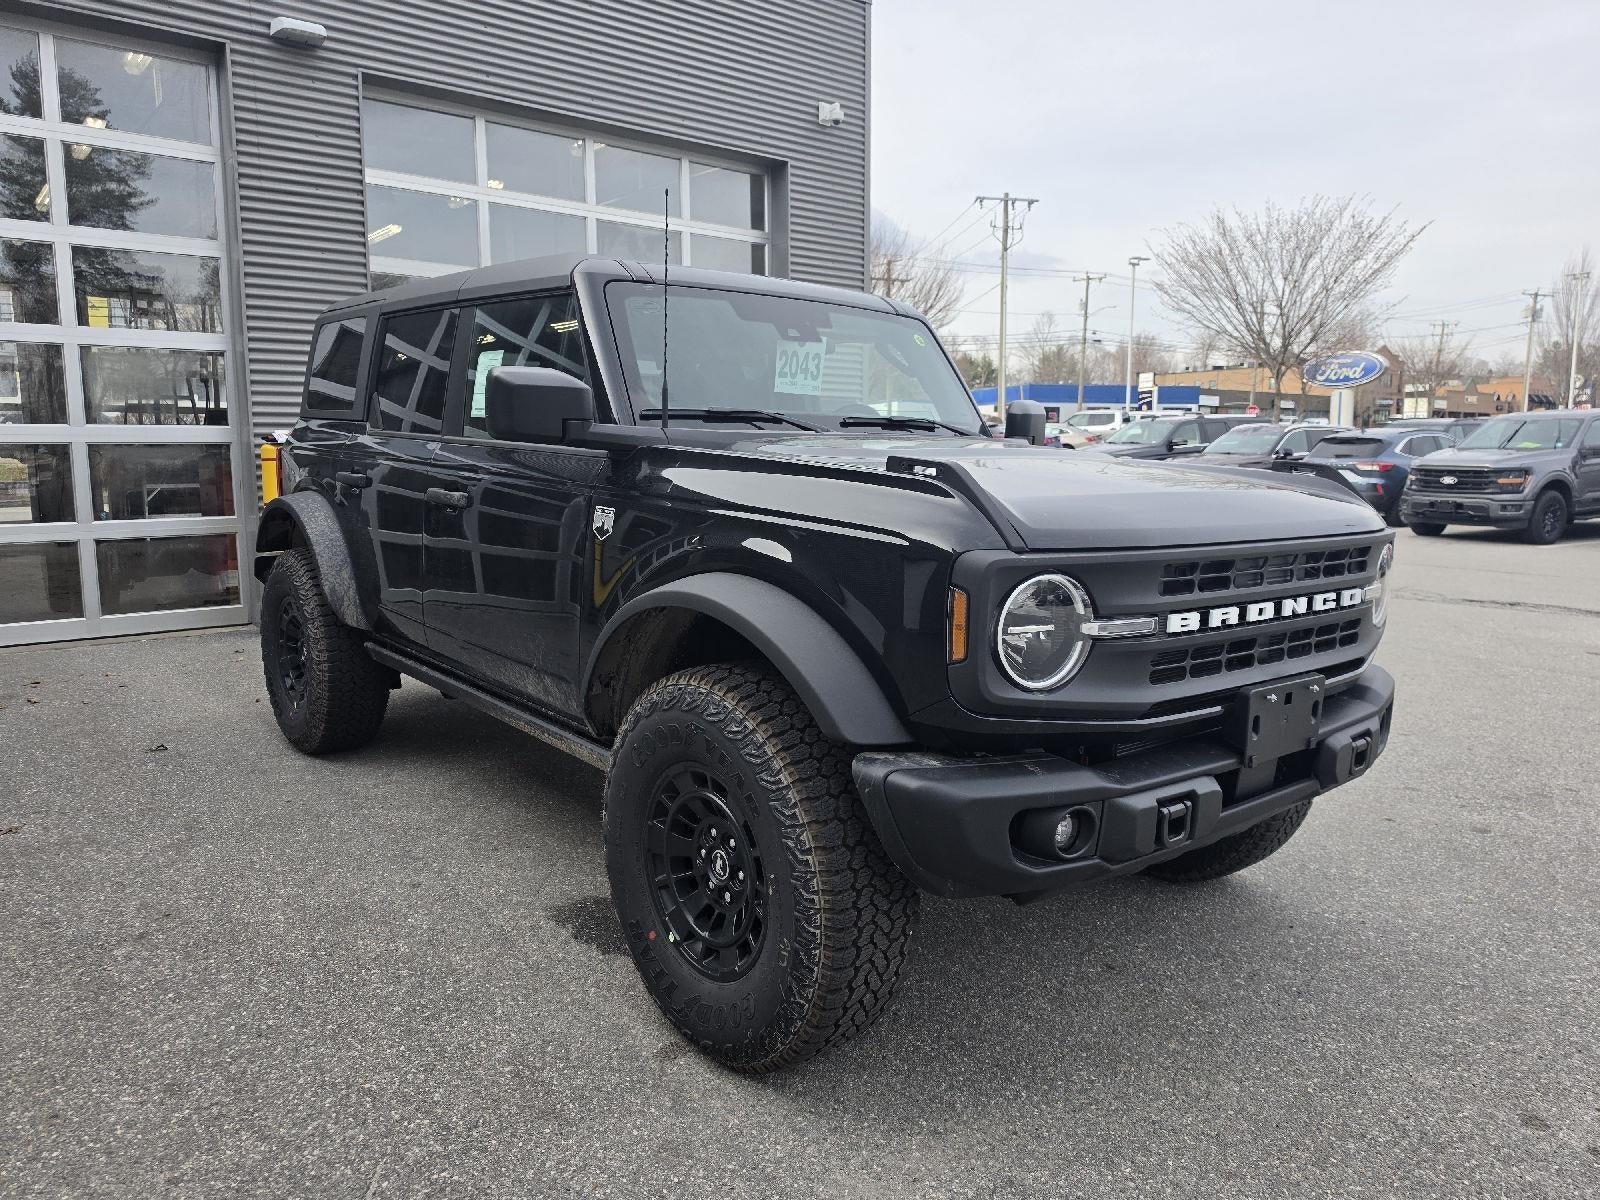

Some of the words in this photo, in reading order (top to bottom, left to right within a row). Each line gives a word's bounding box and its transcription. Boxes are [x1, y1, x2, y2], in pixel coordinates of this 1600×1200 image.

[778, 350, 821, 381] 2043
[1316, 362, 1366, 381] Ford
[1166, 588, 1362, 634] BRONCO
[630, 722, 761, 820] GOODYEAR
[627, 918, 758, 1033] GOODYEAR
